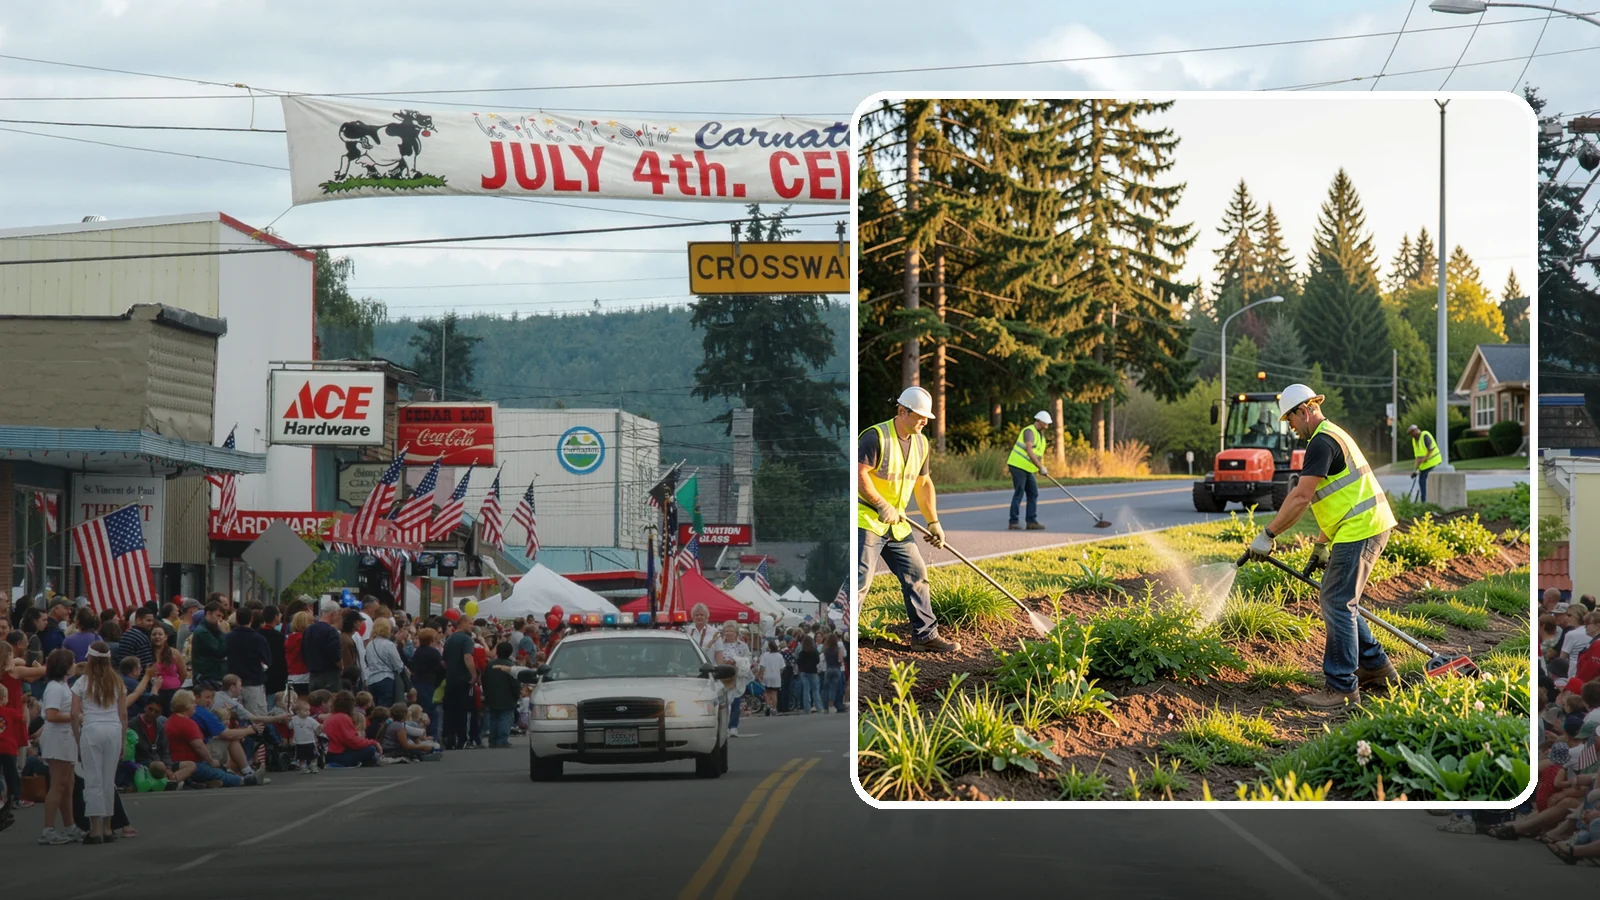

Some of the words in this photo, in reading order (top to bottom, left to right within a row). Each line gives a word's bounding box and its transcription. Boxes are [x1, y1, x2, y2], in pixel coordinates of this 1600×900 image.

[695, 121, 850, 149] Carnat
[481, 141, 605, 192] JULY
[632, 150, 746, 198] 4th.
[697, 254, 850, 280] CROSSWA
[282, 380, 374, 419] ACE
[406, 409, 452, 421] CEDAR
[283, 421, 371, 436] Hardware
[416, 428, 477, 447] Coca-Cola
[353, 467, 385, 481] Simpl
[95, 485, 124, 494] Vincent
[126, 486, 135, 494] de
[138, 486, 155, 495] Paul
[688, 527, 741, 535] CRNATION
[699, 535, 730, 543] GLASS
